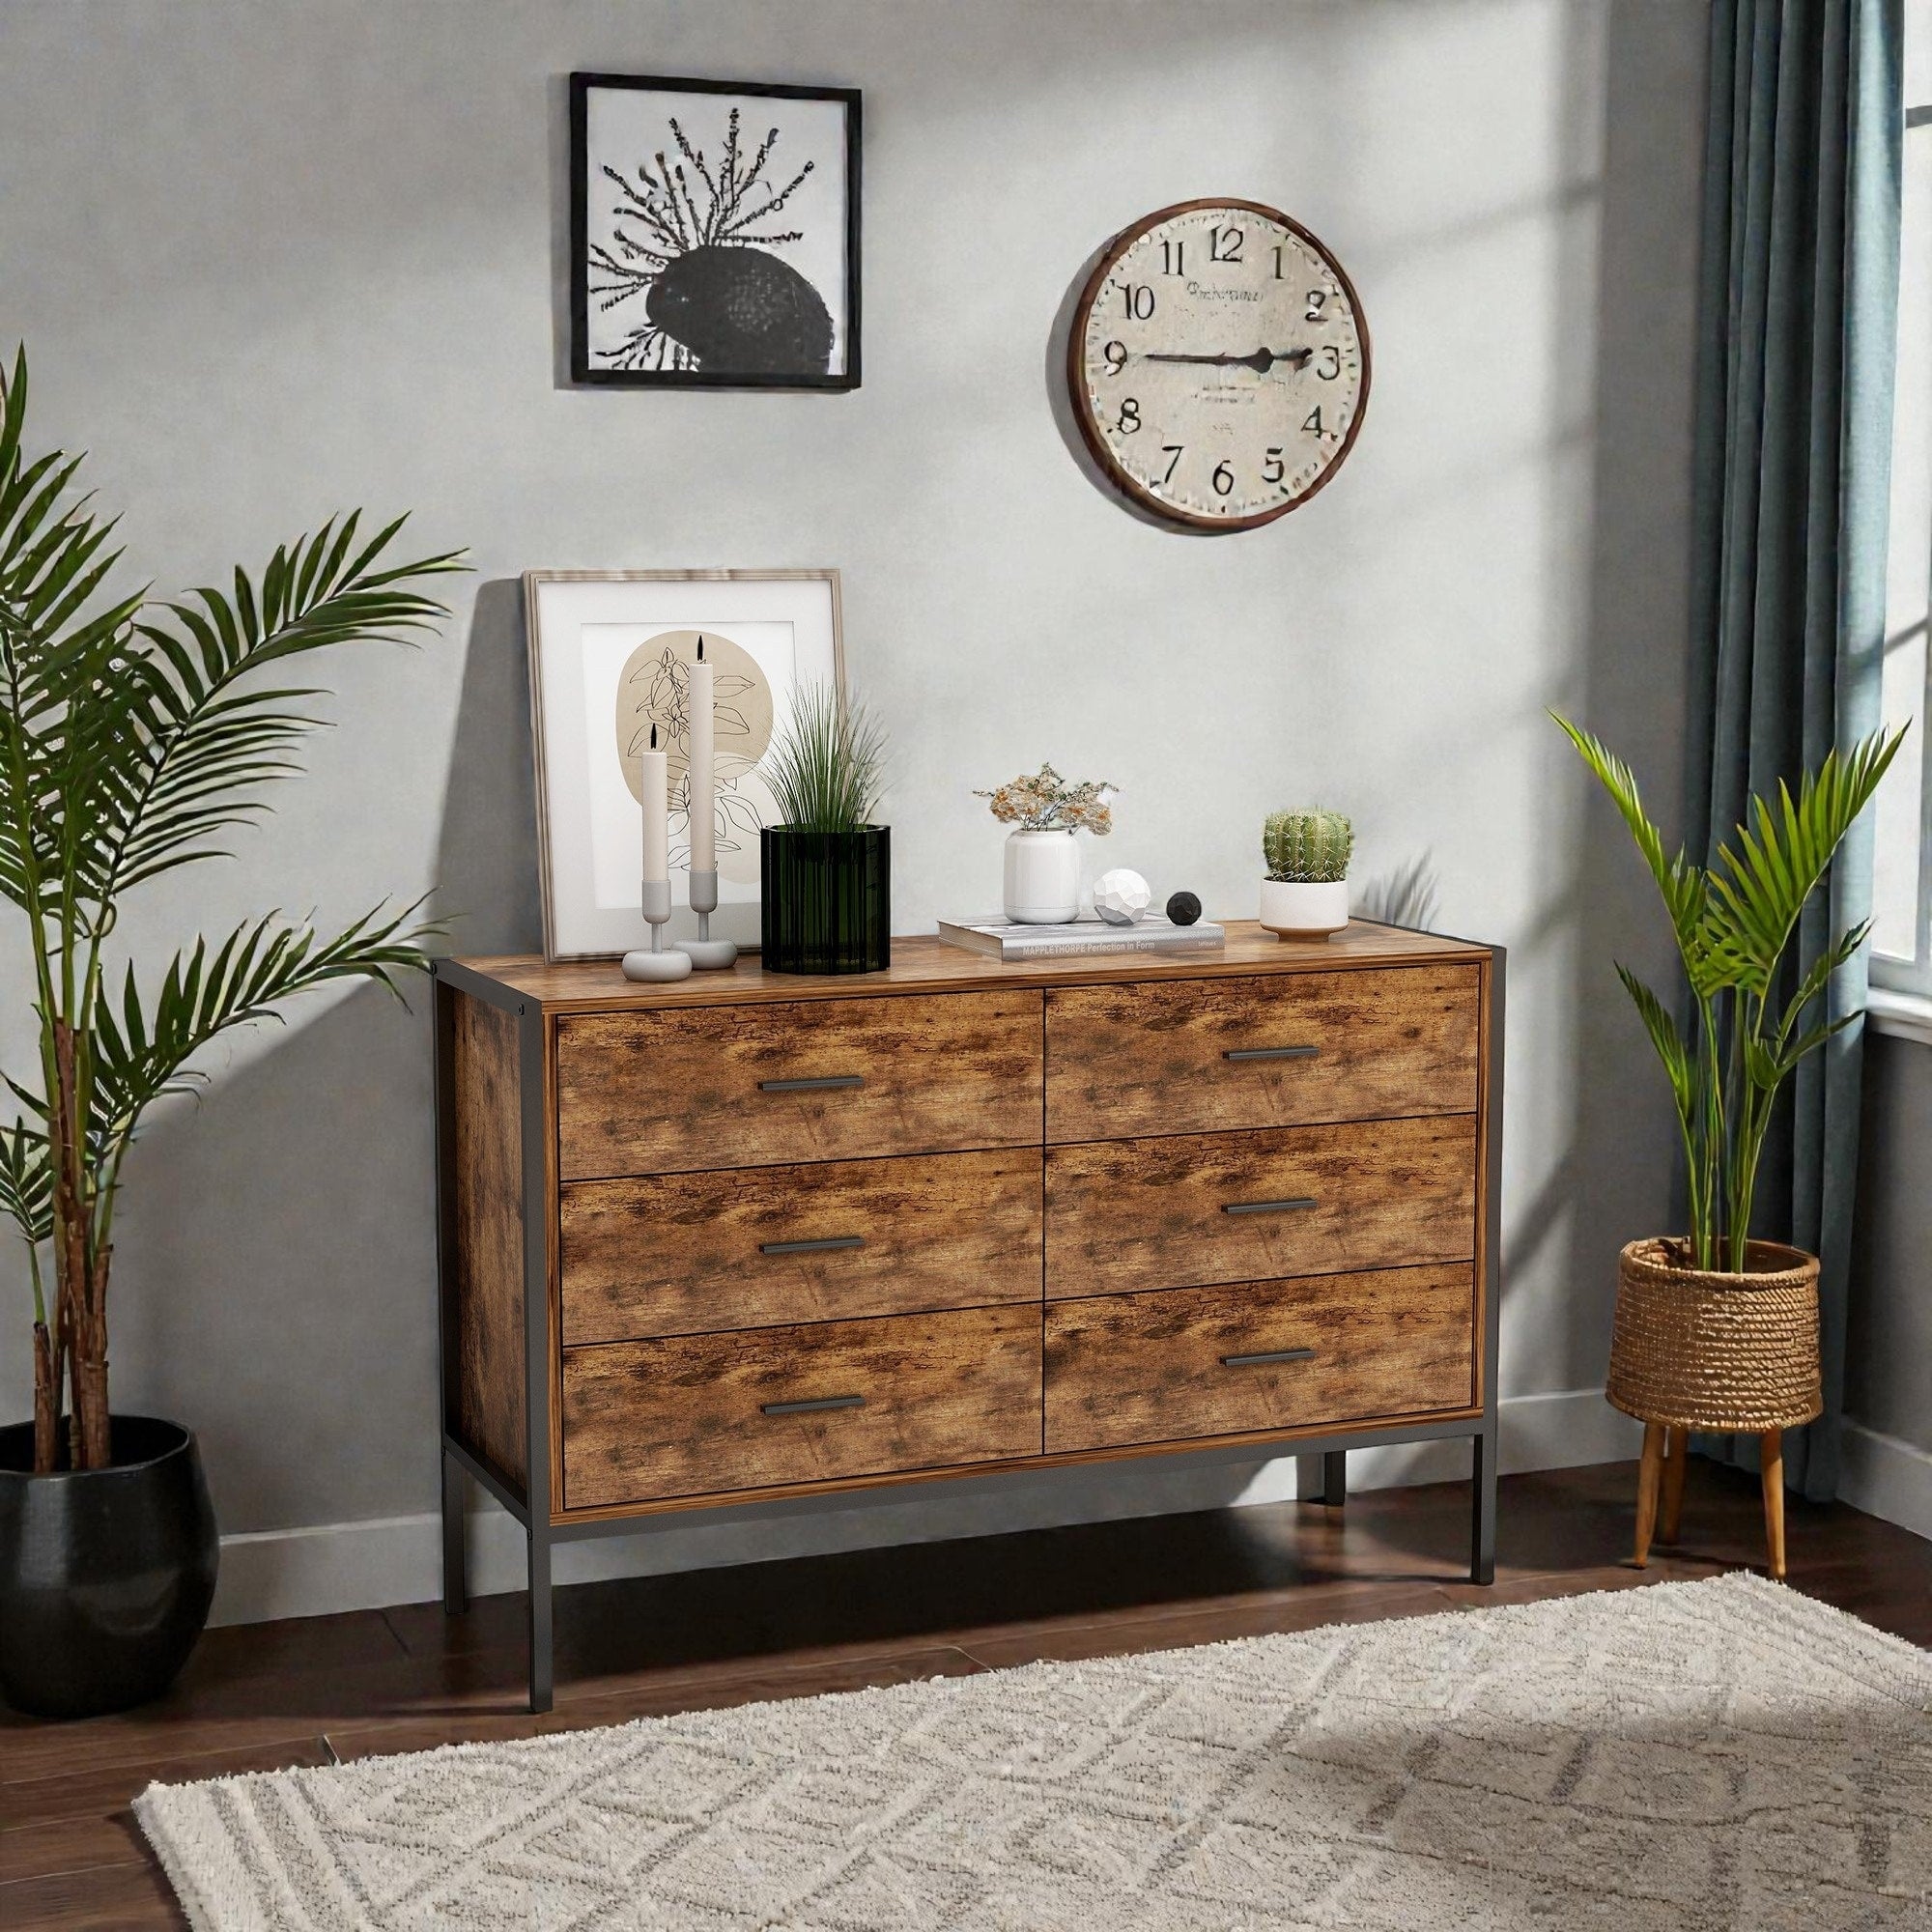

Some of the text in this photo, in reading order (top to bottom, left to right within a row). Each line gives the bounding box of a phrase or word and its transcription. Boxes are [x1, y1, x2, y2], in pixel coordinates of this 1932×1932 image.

[1160, 240, 1184, 276] 11
[1209, 224, 1244, 262] 12
[1271, 245, 1286, 280] 1
[1119, 284, 1155, 320] 10
[1305, 289, 1329, 322] 2
[1104, 340, 1128, 377] 9
[1317, 346, 1341, 381] 3
[1118, 398, 1142, 434] 8
[1301, 406, 1326, 440] 4
[1162, 445, 1184, 484] 7
[1212, 459, 1235, 497] 6
[1262, 447, 1285, 483] 5
[1022, 943, 1087, 955] MAPPLETHORPE
[1088, 942, 1125, 952] Perfection
[1136, 940, 1155, 950] Form
